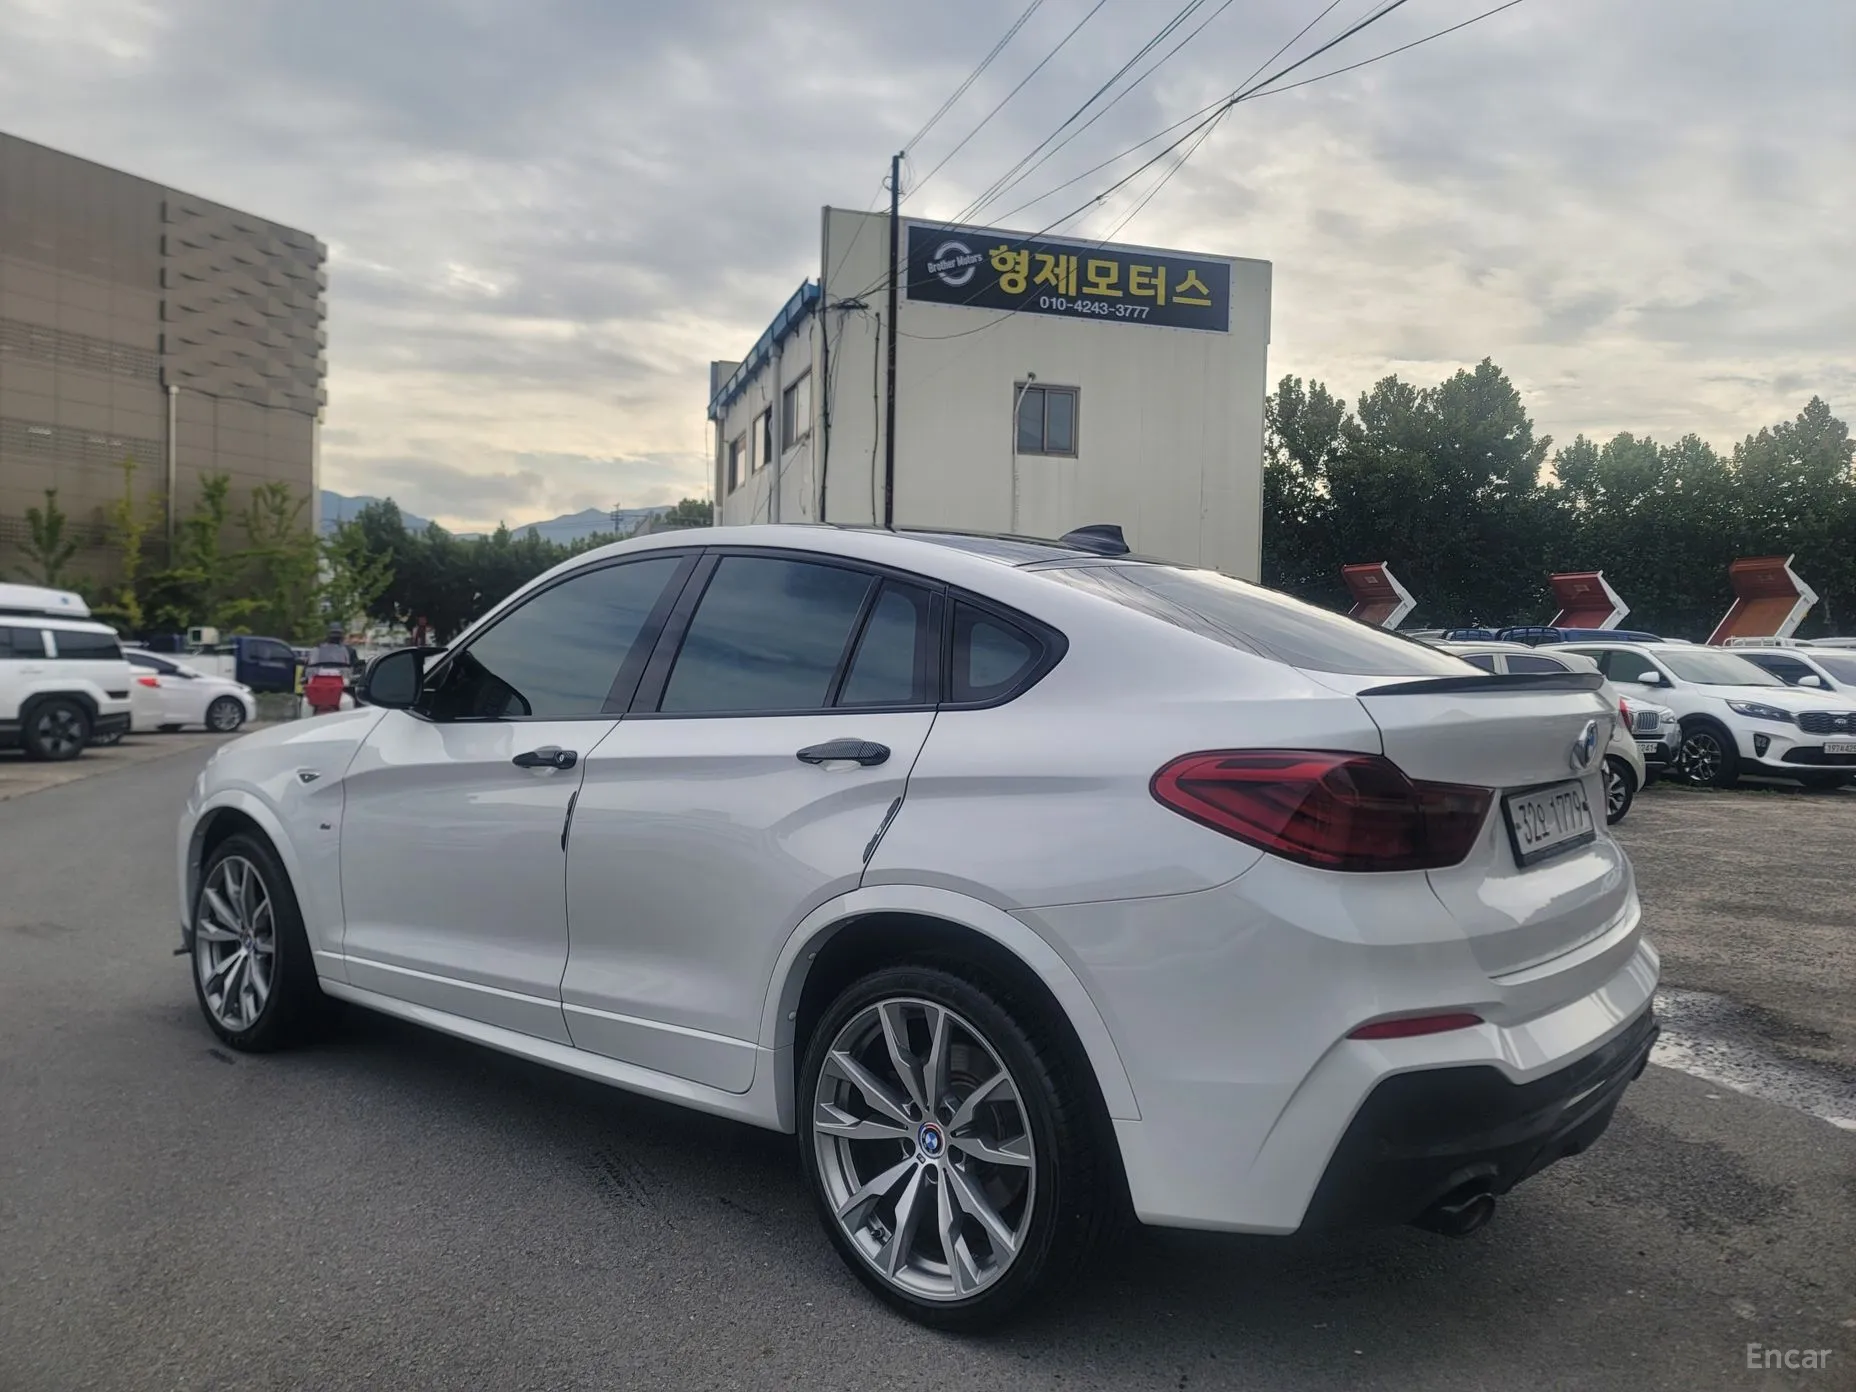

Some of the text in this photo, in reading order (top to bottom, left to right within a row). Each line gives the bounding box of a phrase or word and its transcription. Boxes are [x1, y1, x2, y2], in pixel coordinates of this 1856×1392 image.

[927, 254, 983, 273] Brother Motors
[989, 245, 1212, 306] 형제모터스
[1039, 296, 1150, 319] 010-4243-3777
[1550, 790, 1584, 834] 1779
